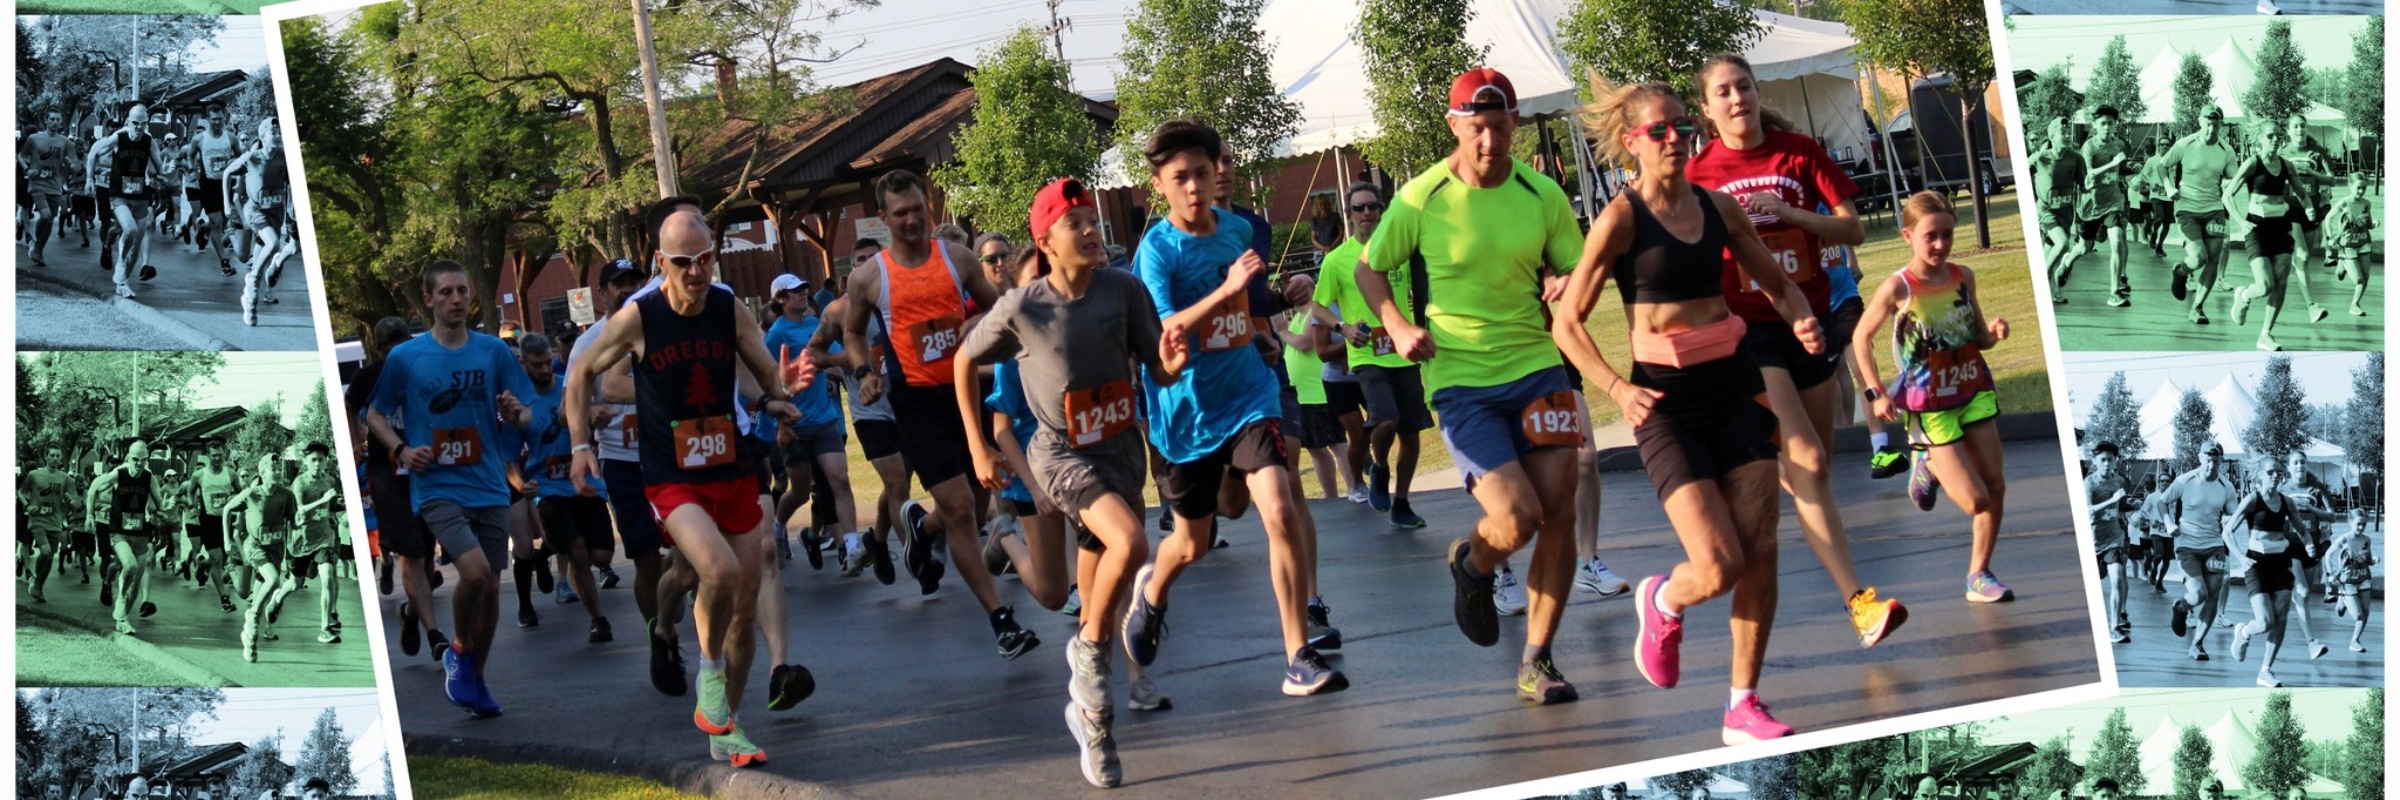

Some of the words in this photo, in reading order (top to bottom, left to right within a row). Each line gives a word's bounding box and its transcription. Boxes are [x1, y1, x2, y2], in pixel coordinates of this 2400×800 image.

[1821, 245, 1840, 260] 208
[1212, 312, 1246, 338] 296
[922, 329, 956, 352] 285
[450, 369, 485, 391] SJB
[1937, 361, 1977, 387] 1245
[1075, 398, 1130, 433] 1243
[1529, 411, 1579, 432] 1923
[441, 440, 471, 458] 291
[687, 433, 726, 457] 298
